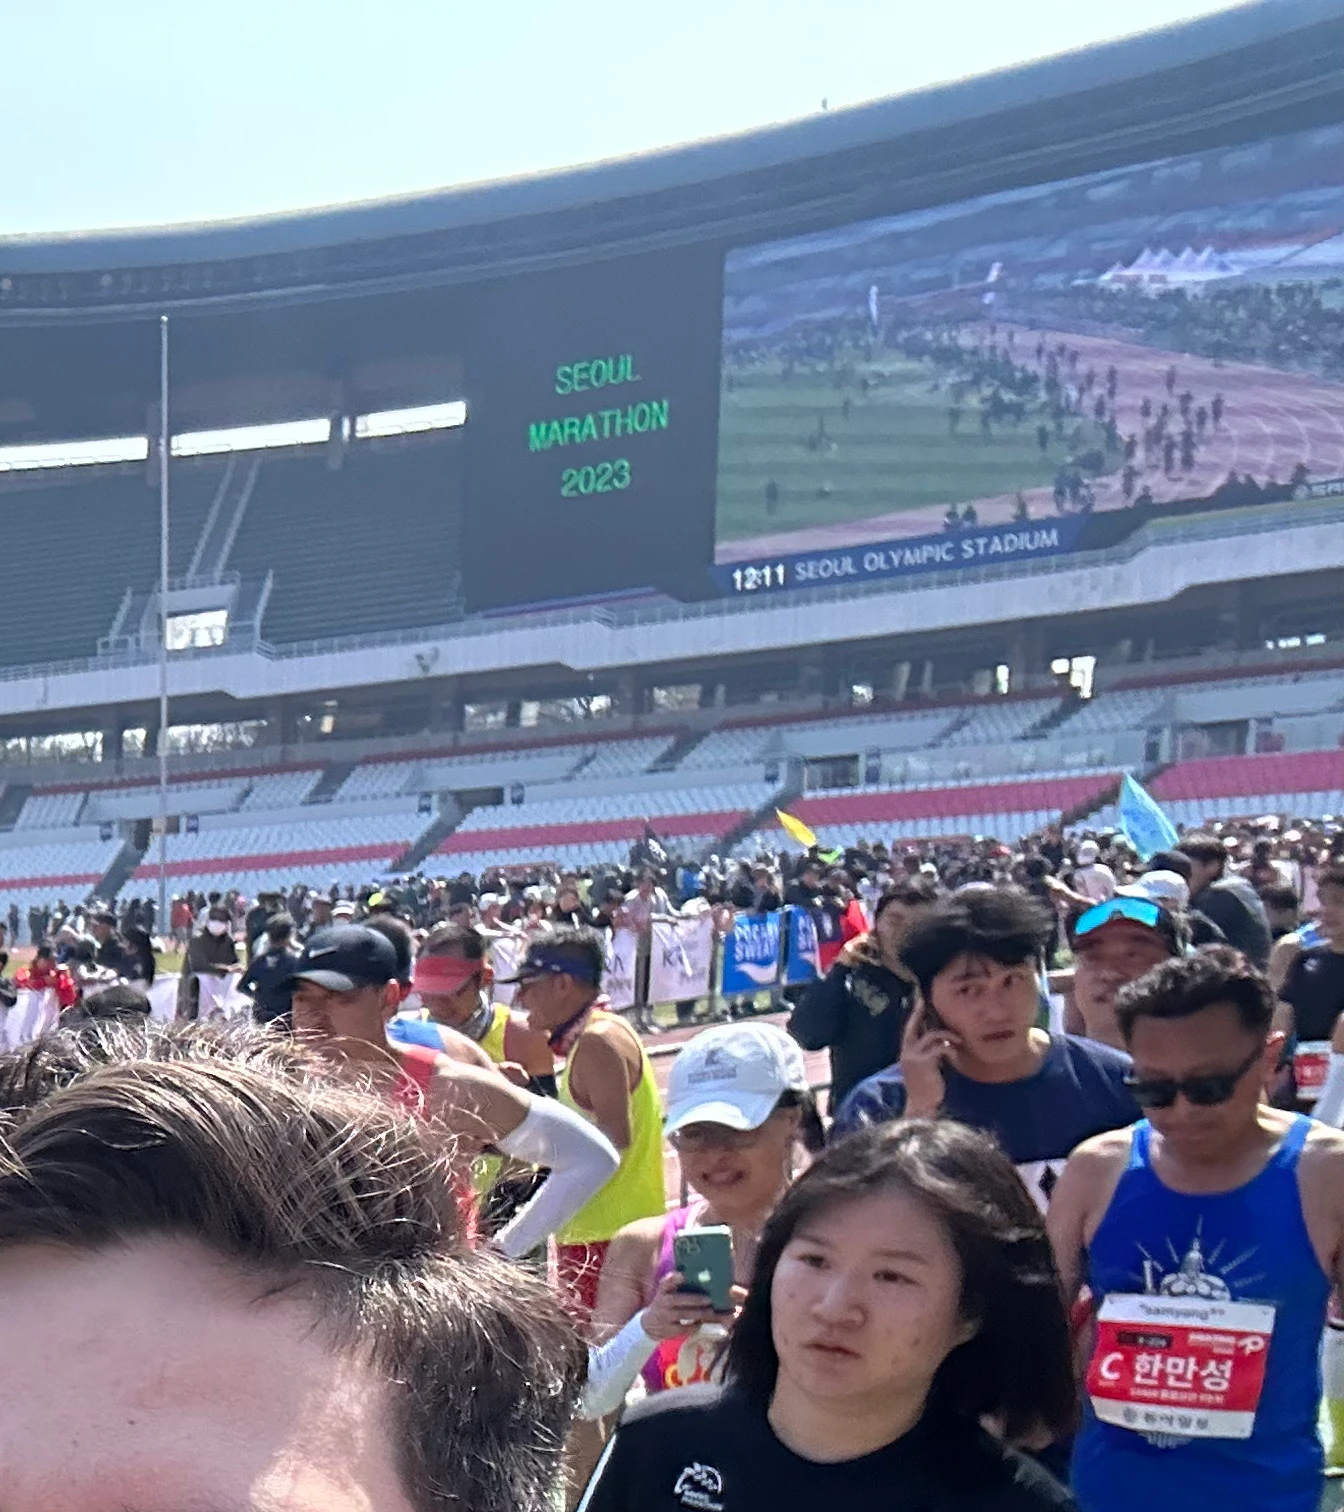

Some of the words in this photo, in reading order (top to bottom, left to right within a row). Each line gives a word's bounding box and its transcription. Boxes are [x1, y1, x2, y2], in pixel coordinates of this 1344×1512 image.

[555, 353, 642, 395] SEOUL
[528, 398, 669, 452] MARATHON
[561, 458, 632, 497] 2023
[732, 563, 786, 591] 12:11
[795, 556, 858, 581] SEOUL
[863, 541, 956, 573] OLYMPIC
[961, 527, 1060, 559] STADIUM
[1134, 1352, 1234, 1393] 한만성
